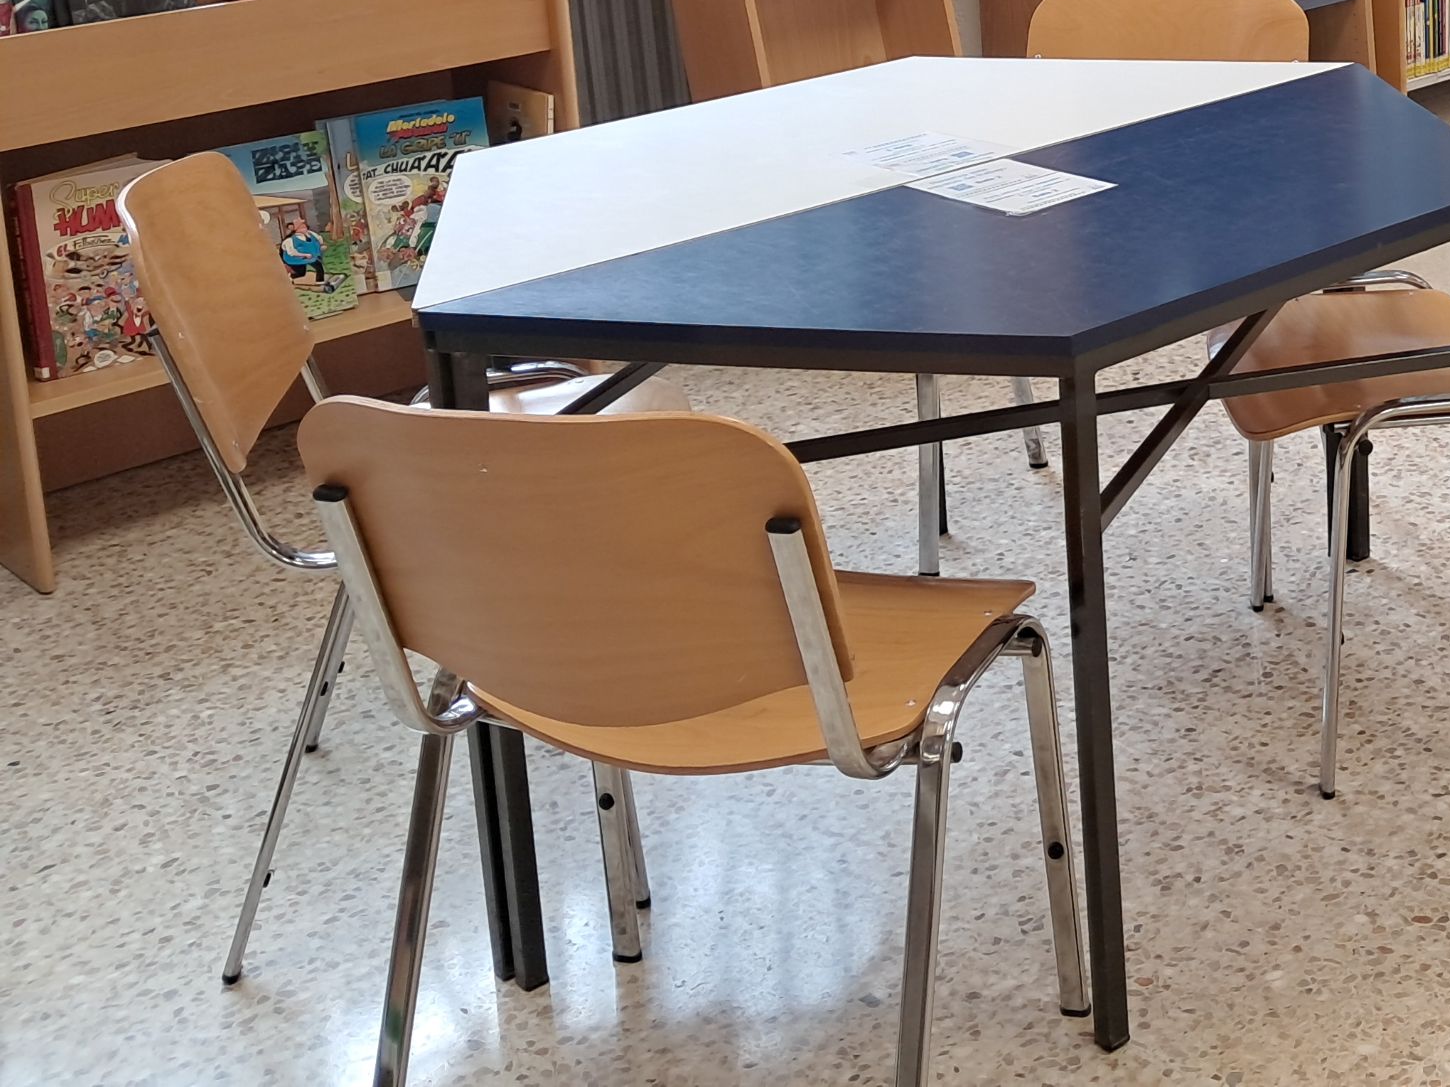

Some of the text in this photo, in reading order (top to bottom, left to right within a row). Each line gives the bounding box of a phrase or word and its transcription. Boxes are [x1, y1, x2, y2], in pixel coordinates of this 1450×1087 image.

[386, 112, 456, 133] Mortadelo
[380, 144, 397, 159] LA
[401, 134, 447, 155] GRIPE
[48, 179, 120, 221] Super
[53, 198, 122, 237] HUM
[56, 243, 69, 258] EL
